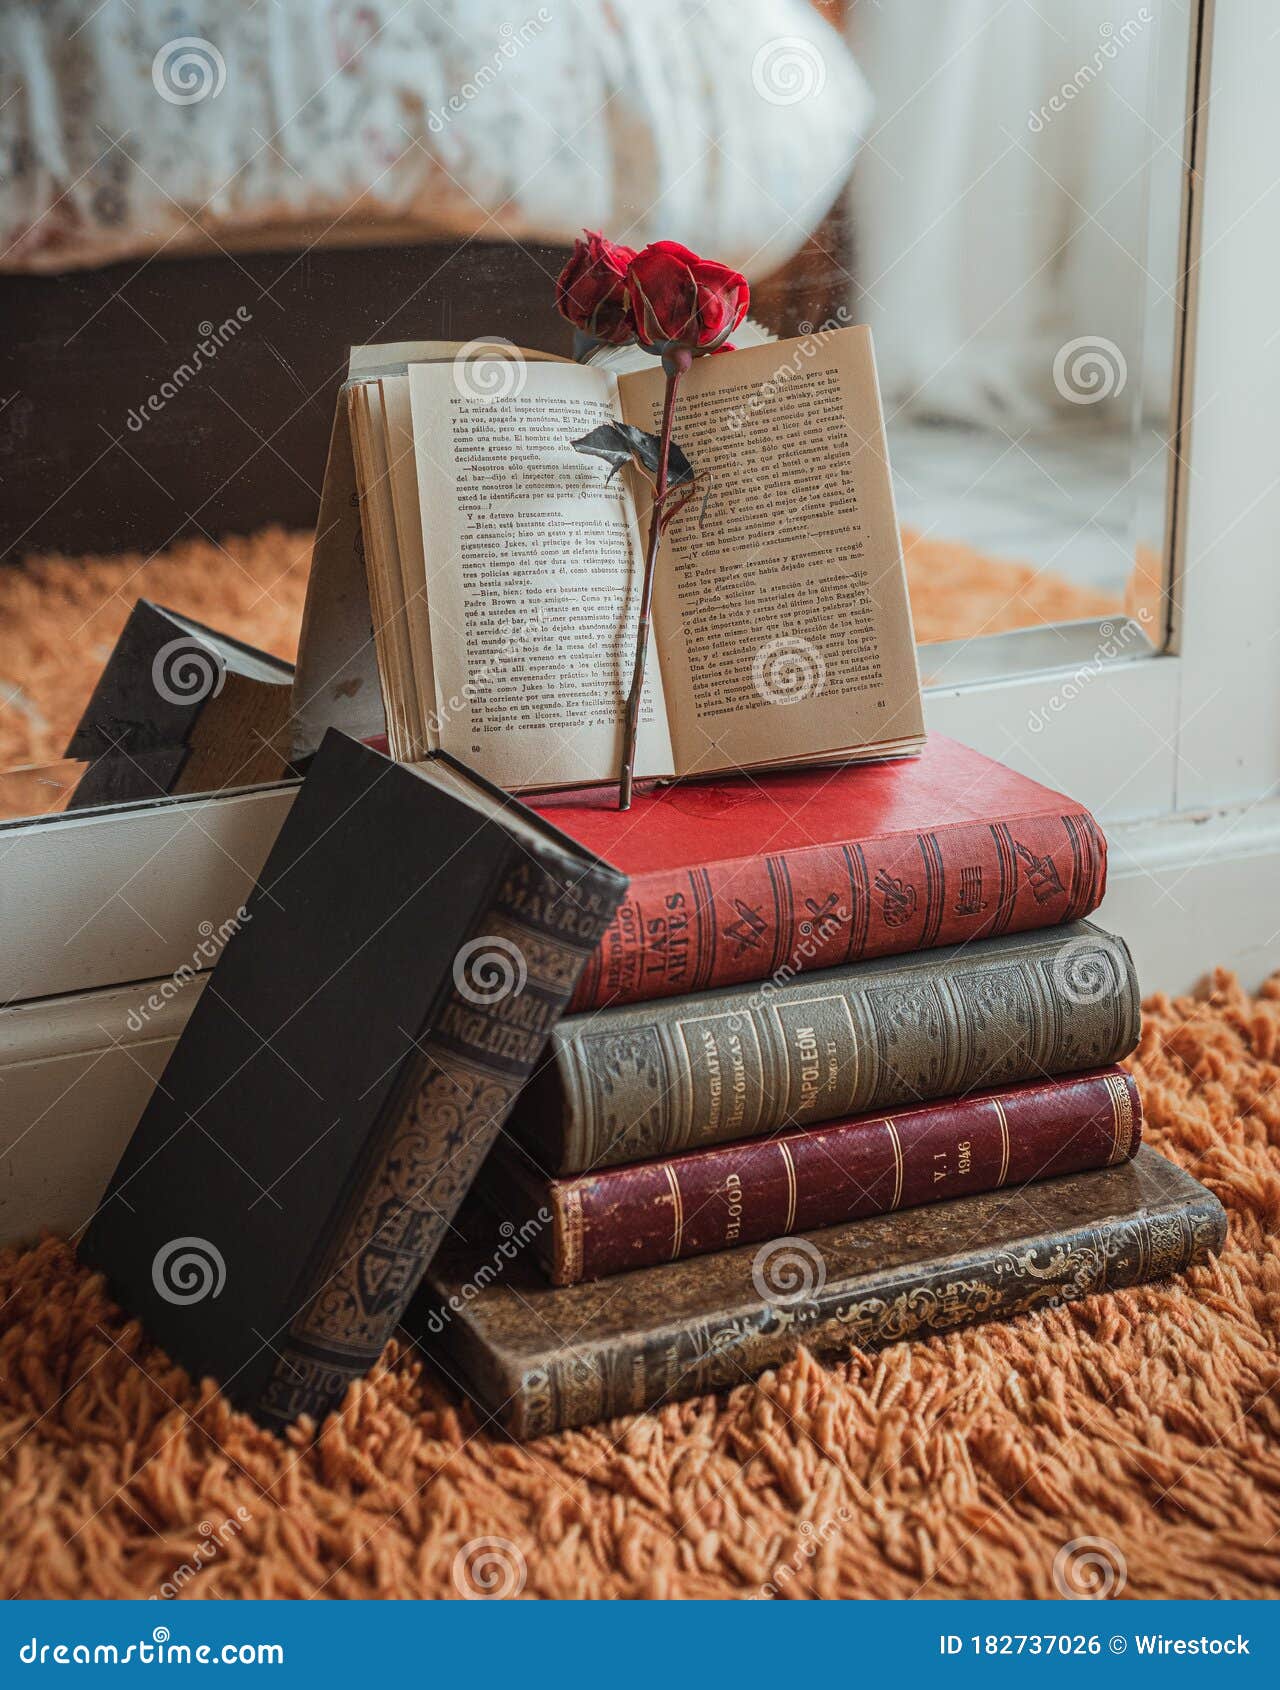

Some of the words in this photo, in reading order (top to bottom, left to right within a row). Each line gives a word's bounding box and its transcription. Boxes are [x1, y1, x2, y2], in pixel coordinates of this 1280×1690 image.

[828, 431, 848, 440] visita
[782, 458, 801, 467] hotel
[824, 451, 851, 460] alguien
[745, 520, 776, 530] anónimo
[717, 535, 745, 544] hombre
[748, 530, 775, 540] pudiera
[694, 568, 716, 576] Padre
[791, 547, 833, 561] gravemente
[836, 541, 863, 552] recogió
[780, 561, 805, 571] dejado
[725, 589, 755, 599] solicitar
[753, 605, 775, 613] cartas
[777, 601, 788, 609] del
[816, 594, 834, 602] John
[804, 614, 834, 625] publicar
[694, 625, 708, 633] más
[791, 623, 827, 635] Dirección
[521, 683, 543, 691] Jukes
[876, 701, 886, 709] 81
[471, 745, 481, 753] 60
[665, 892, 689, 983] ARTES
[646, 917, 667, 974] LAS
[827, 1040, 837, 1054] II
[795, 1026, 819, 1109] NAPOLEÓN
[827, 1058, 838, 1094] TOMO
[958, 1141, 971, 1175] 1946
[725, 1173, 742, 1240] BLOOD
